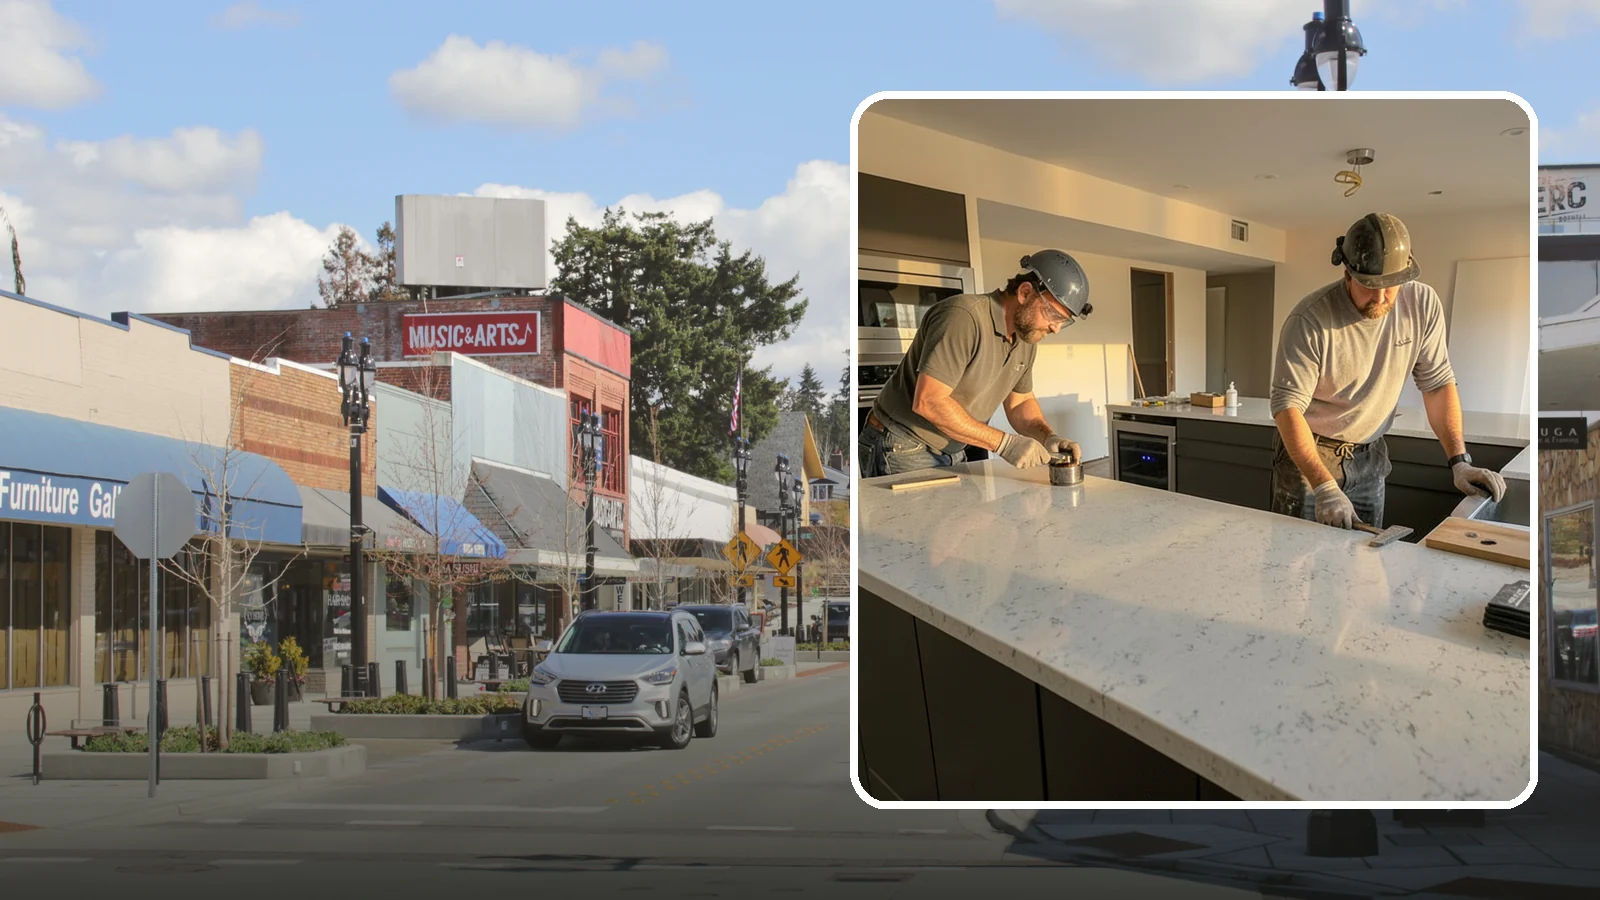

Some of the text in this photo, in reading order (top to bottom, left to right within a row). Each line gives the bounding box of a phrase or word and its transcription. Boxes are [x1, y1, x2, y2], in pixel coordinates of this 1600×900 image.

[408, 322, 520, 349] MUSIC&ARTS
[0, 471, 122, 519] Furniture Gal
